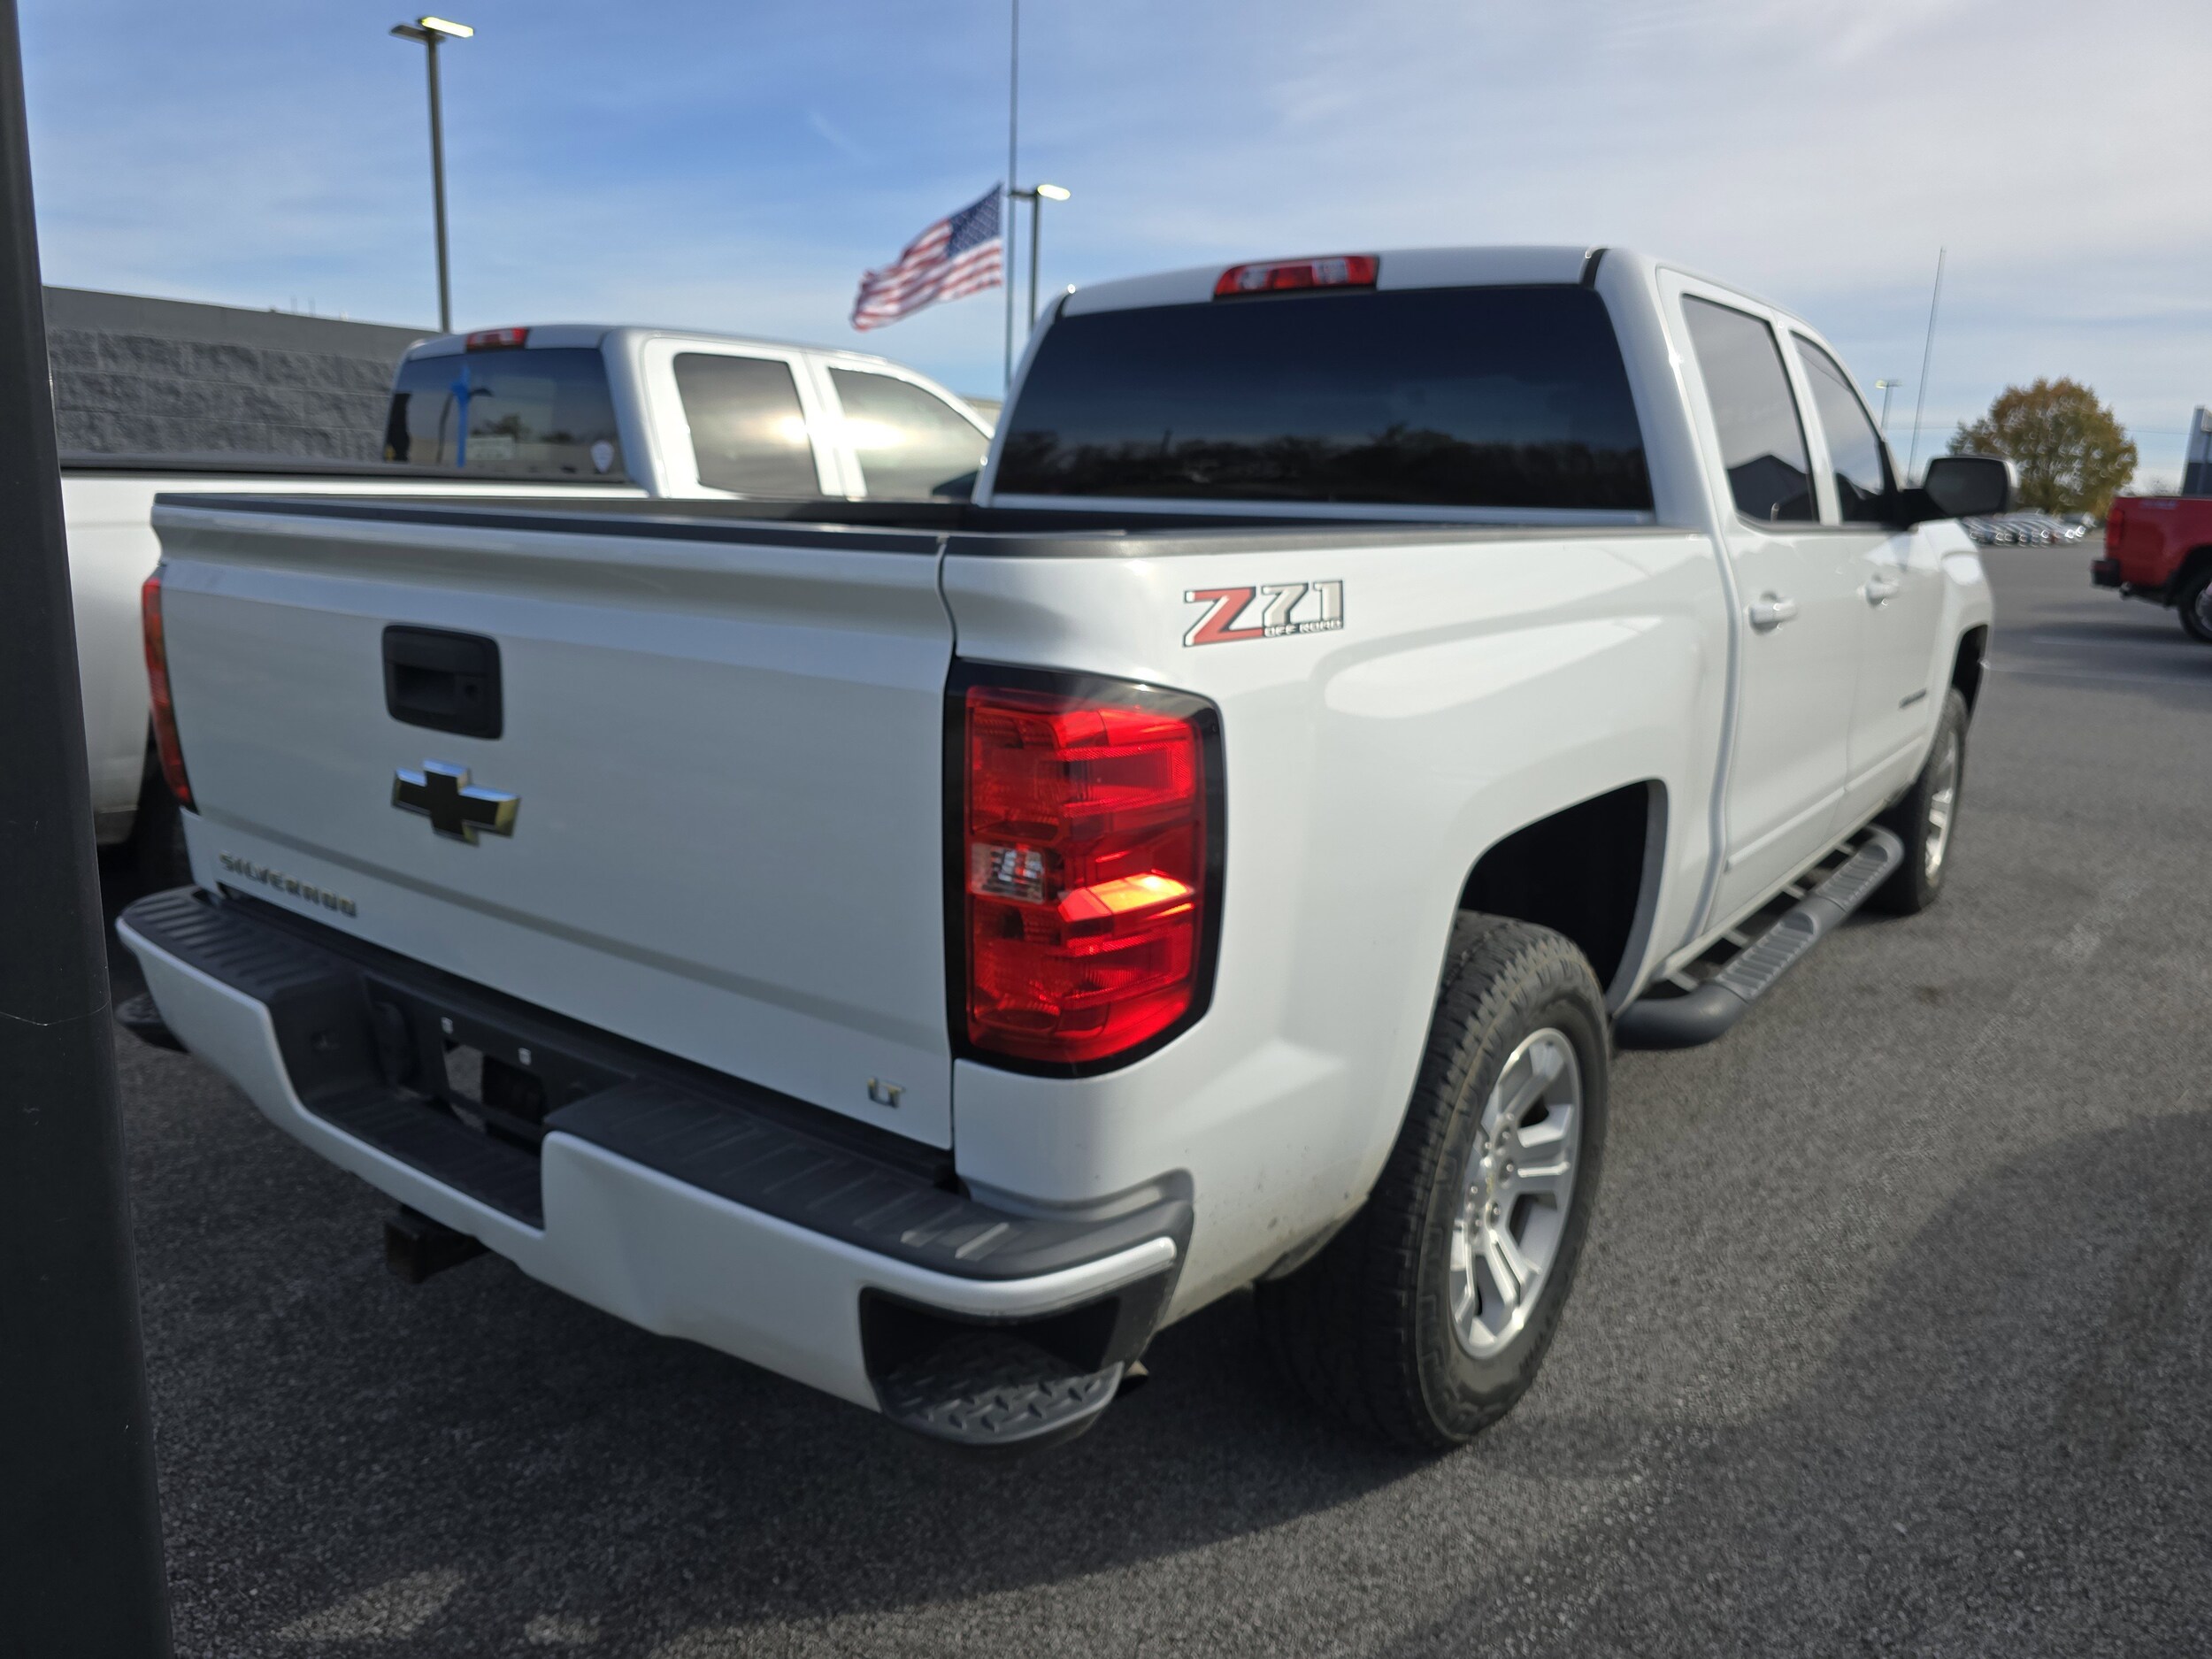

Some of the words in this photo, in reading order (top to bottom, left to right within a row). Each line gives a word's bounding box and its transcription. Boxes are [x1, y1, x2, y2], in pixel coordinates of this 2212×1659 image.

[1183, 580, 1344, 648] Z71
[1263, 624, 1297, 637] OFF
[1299, 619, 1342, 634] ROAD
[868, 1076, 906, 1110] LT
